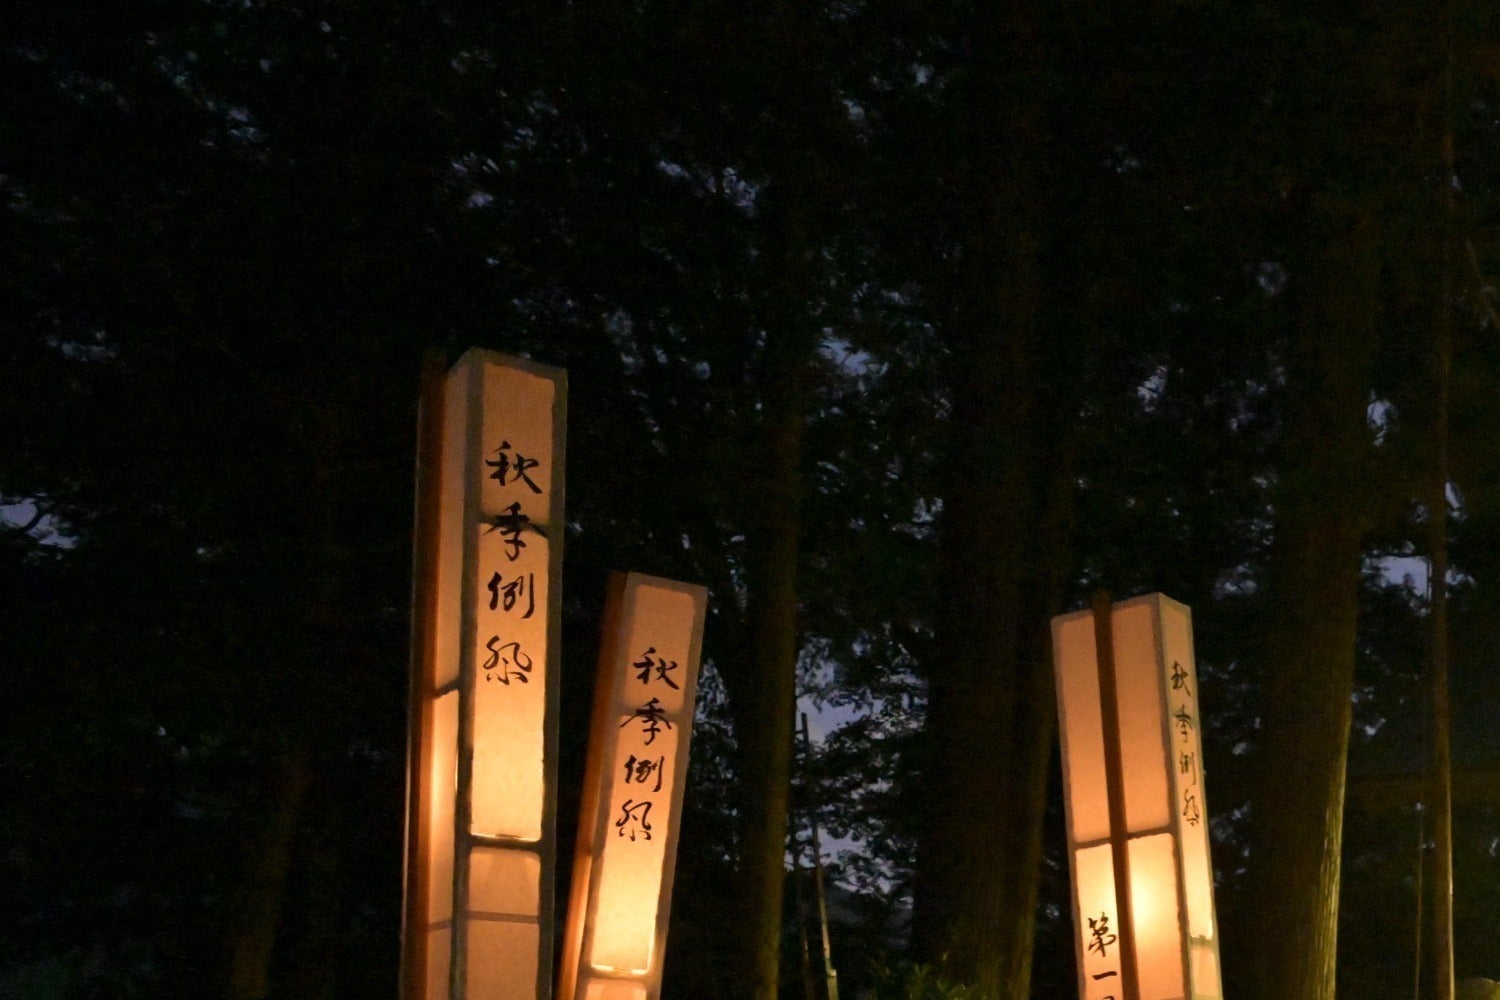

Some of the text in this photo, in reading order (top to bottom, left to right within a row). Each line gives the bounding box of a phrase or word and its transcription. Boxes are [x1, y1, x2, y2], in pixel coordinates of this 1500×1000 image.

[483, 440, 549, 686] 秋季例祭
[615, 647, 680, 842] 秋季例祭
[1170, 661, 1201, 827] 秋季例祭
